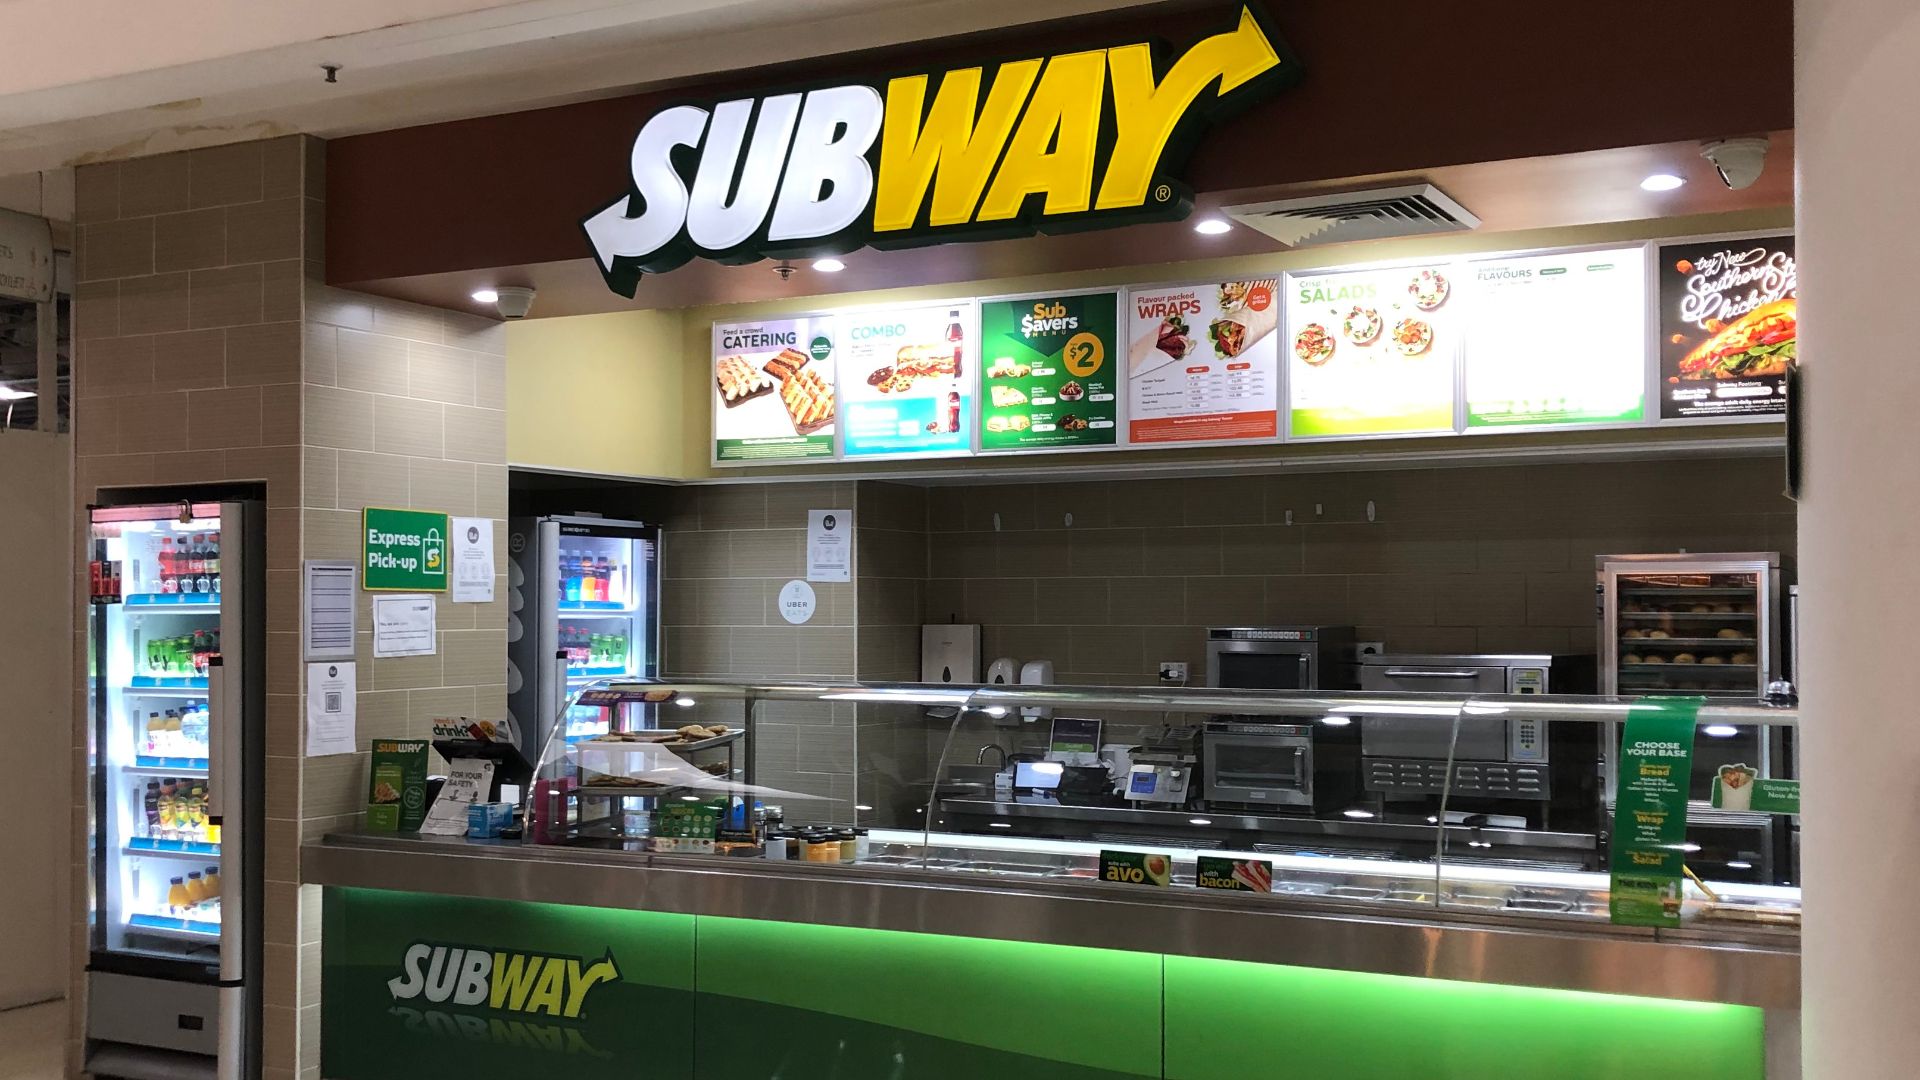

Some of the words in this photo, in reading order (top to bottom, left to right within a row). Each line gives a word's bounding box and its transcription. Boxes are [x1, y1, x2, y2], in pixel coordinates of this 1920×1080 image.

[584, 8, 1281, 272] SUBWAY
[1477, 269, 1532, 281] FLAVOURS
[1299, 280, 1321, 288] Crisp
[1138, 296, 1166, 304] Flavour
[1167, 293, 1195, 301] packed
[1300, 283, 1376, 304] SALADS
[1034, 302, 1067, 320] Sub
[1138, 300, 1201, 319] WRAPS
[723, 328, 738, 336] Feed
[851, 323, 906, 341] COMBO
[1033, 329, 1067, 337] MENU
[723, 332, 797, 350] CATERING
[368, 529, 421, 547] Express
[368, 552, 418, 572] Pick-up
[433, 723, 470, 738] drink?
[377, 743, 425, 753] SUBWAY
[1634, 741, 1681, 750] CHOOSE
[1626, 748, 1657, 757] YOUR
[1658, 749, 1688, 758] BASE
[450, 770, 464, 778] FOR
[465, 771, 483, 780] YOUR
[1639, 767, 1670, 776] Bread
[447, 779, 474, 788] SAFETY
[1767, 791, 1786, 799] Now
[1636, 814, 1664, 825] Wrap
[1633, 855, 1662, 865] Salad
[1106, 865, 1145, 883] avo
[1199, 872, 1240, 889] bacon
[387, 943, 618, 1018] SUBWAY
